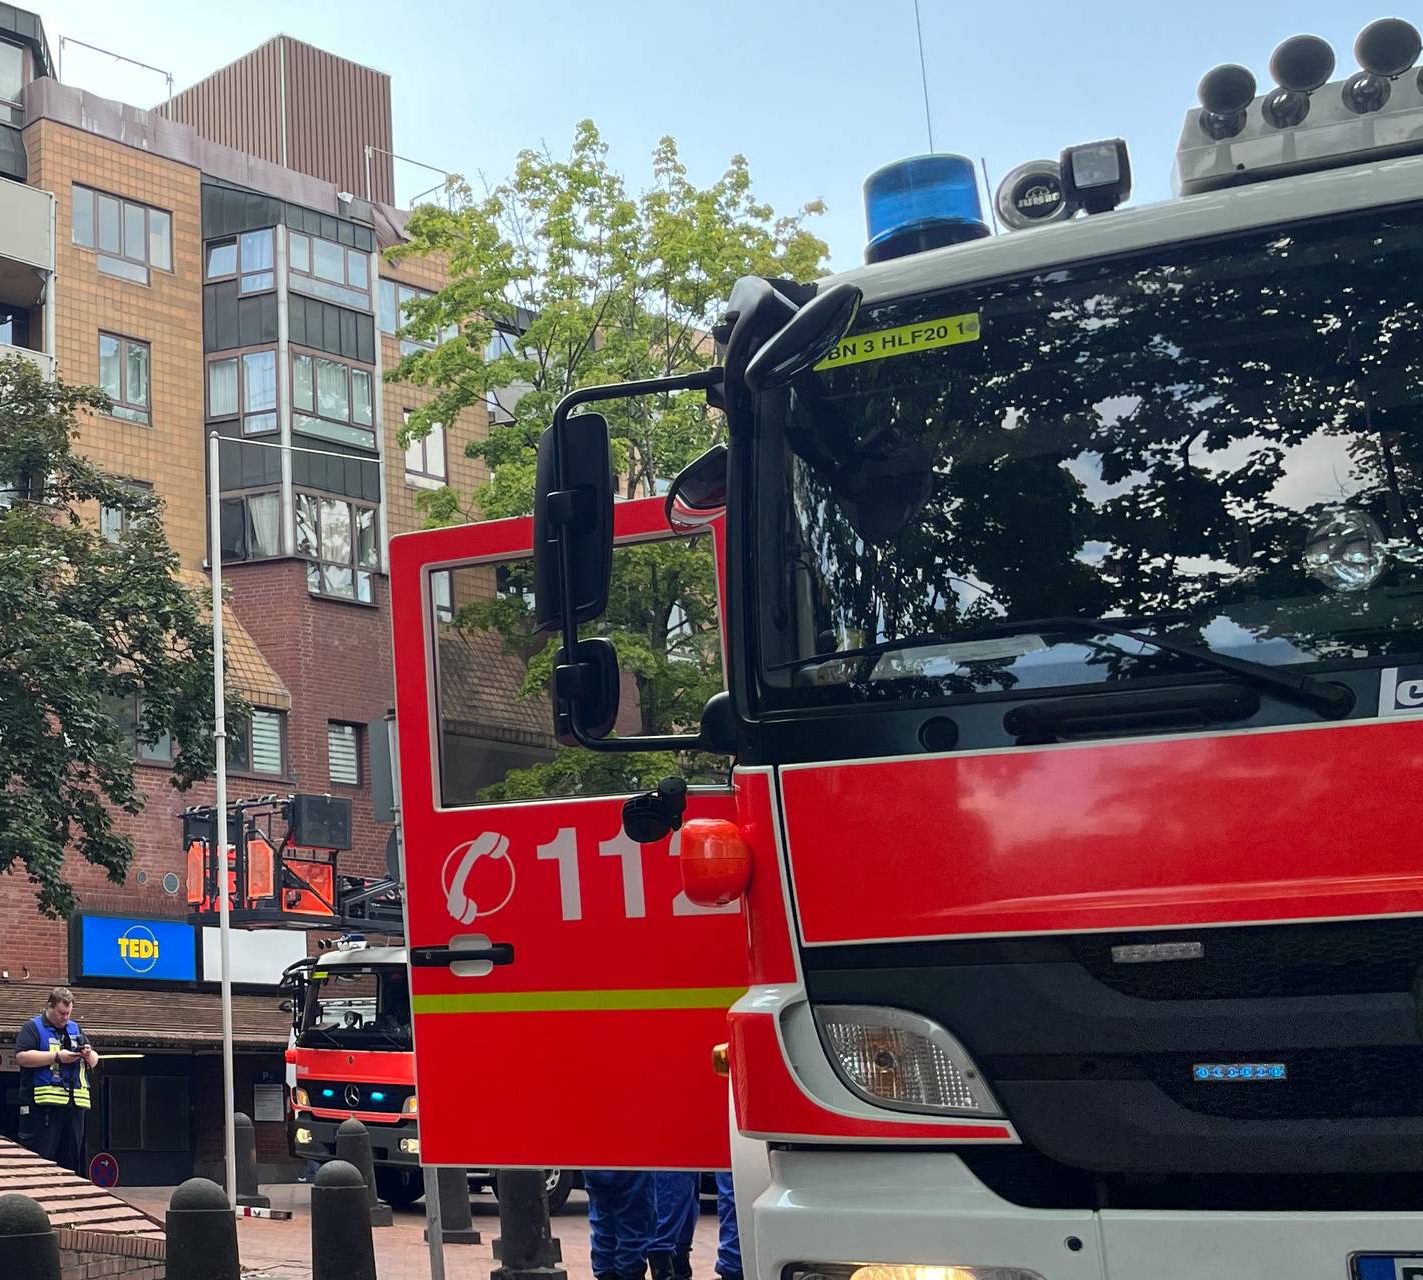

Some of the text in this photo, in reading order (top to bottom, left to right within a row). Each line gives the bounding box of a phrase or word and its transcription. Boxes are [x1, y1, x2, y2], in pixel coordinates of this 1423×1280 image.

[827, 343, 858, 361] BN
[863, 340, 875, 354] 3
[881, 325, 948, 350] HLF20
[117, 938, 159, 959] TEDi
